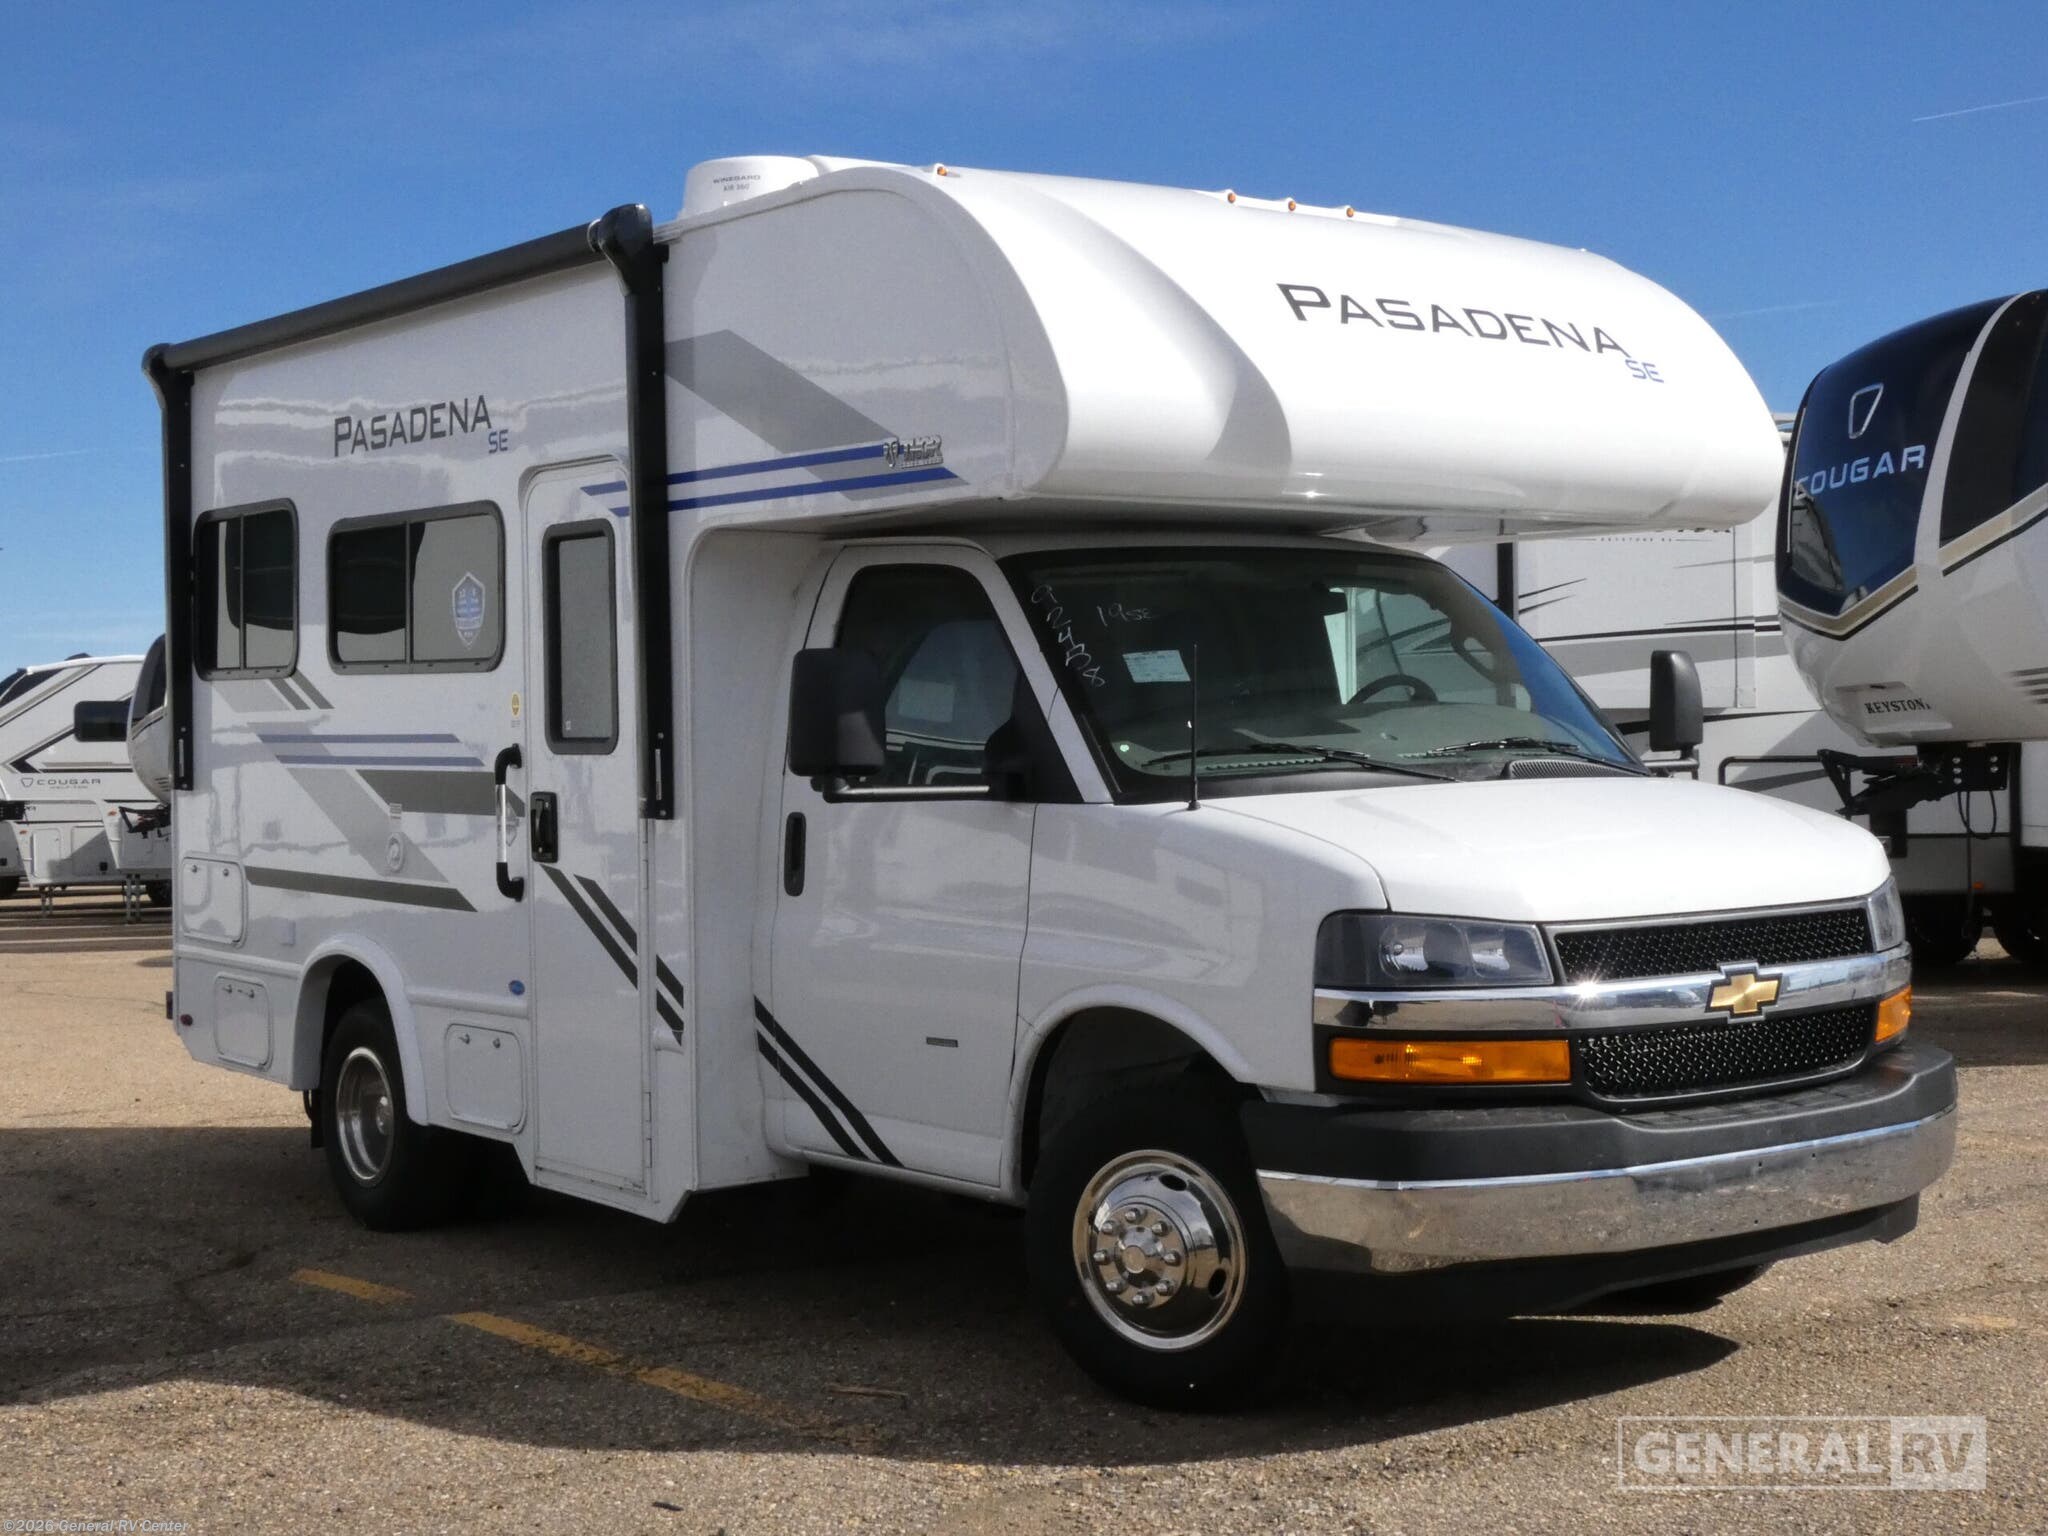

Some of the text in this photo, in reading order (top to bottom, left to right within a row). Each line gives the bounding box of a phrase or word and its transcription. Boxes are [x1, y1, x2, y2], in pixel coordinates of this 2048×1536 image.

[1276, 283, 1632, 358] PASADENA
[1625, 359, 1664, 383] SE
[334, 394, 492, 457] PASADENA
[488, 429, 509, 455] SE
[1793, 444, 1926, 501] COUGAR
[36, 778, 101, 786] COUGAR
